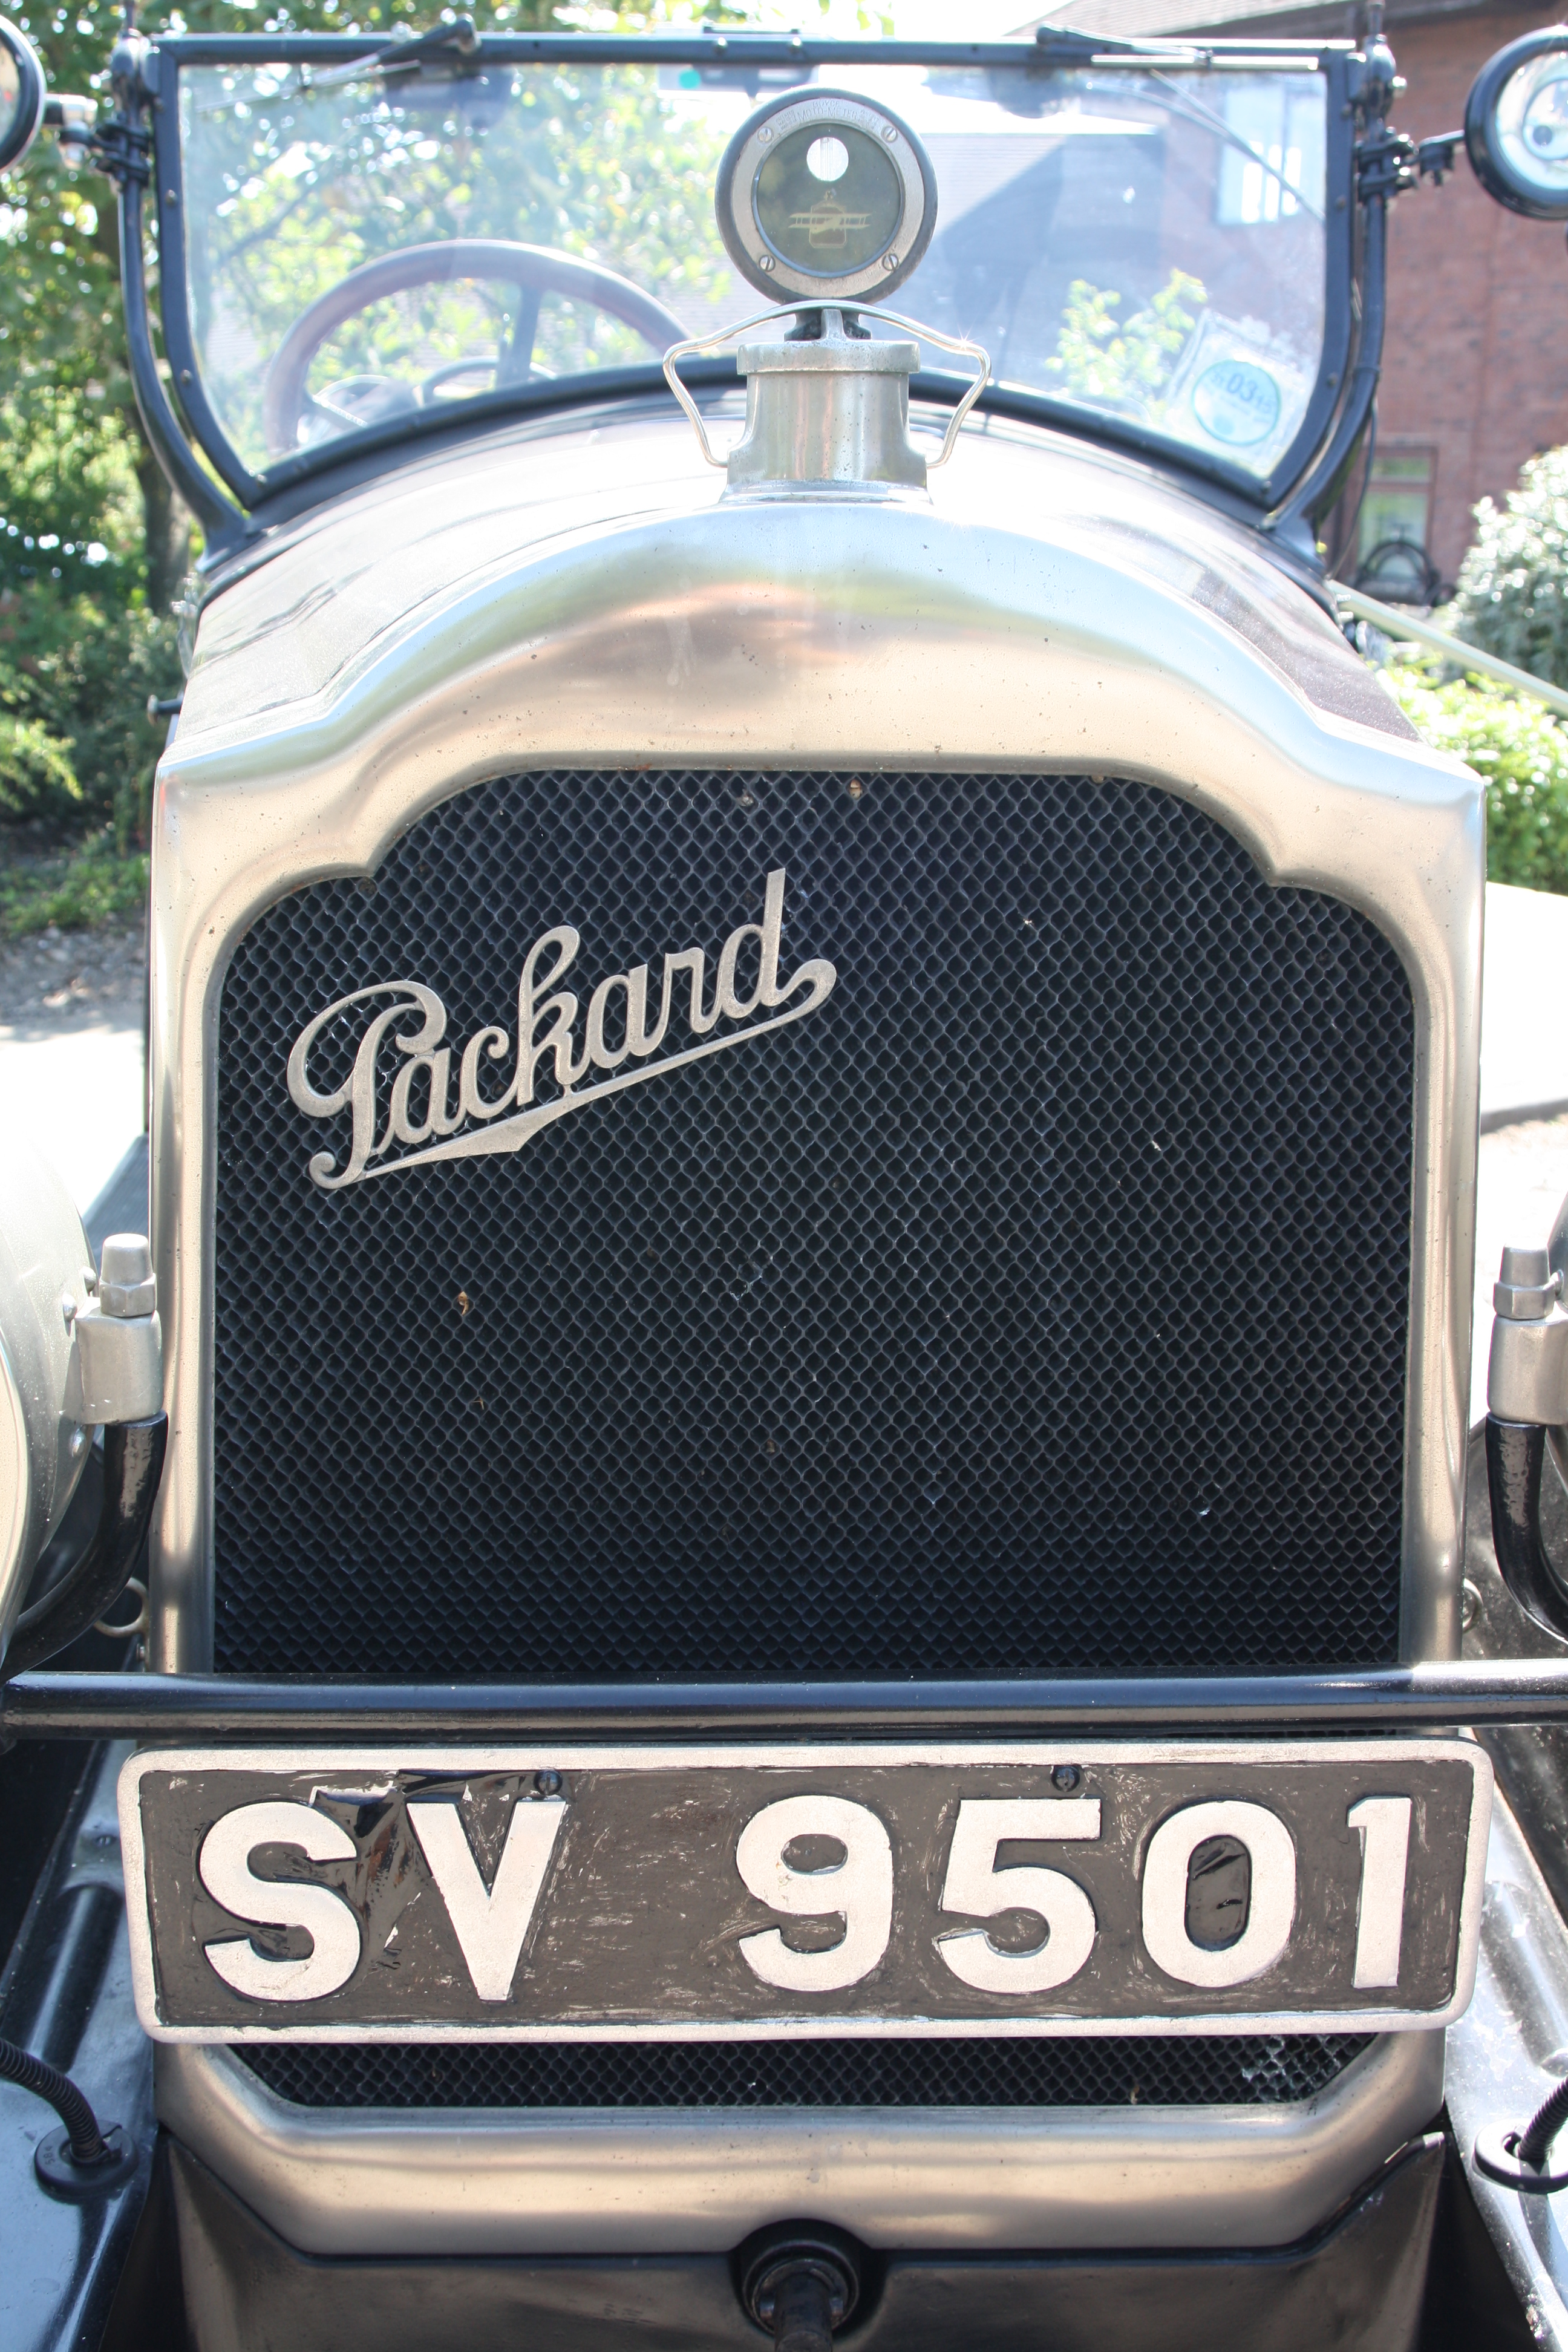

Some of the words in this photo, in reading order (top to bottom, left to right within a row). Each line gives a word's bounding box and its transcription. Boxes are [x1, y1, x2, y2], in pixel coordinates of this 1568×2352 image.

[1227, 373, 1257, 401] 03
[287, 867, 837, 1189] Packard
[197, 1797, 567, 2002] SV
[735, 1794, 1413, 1994] 9501
